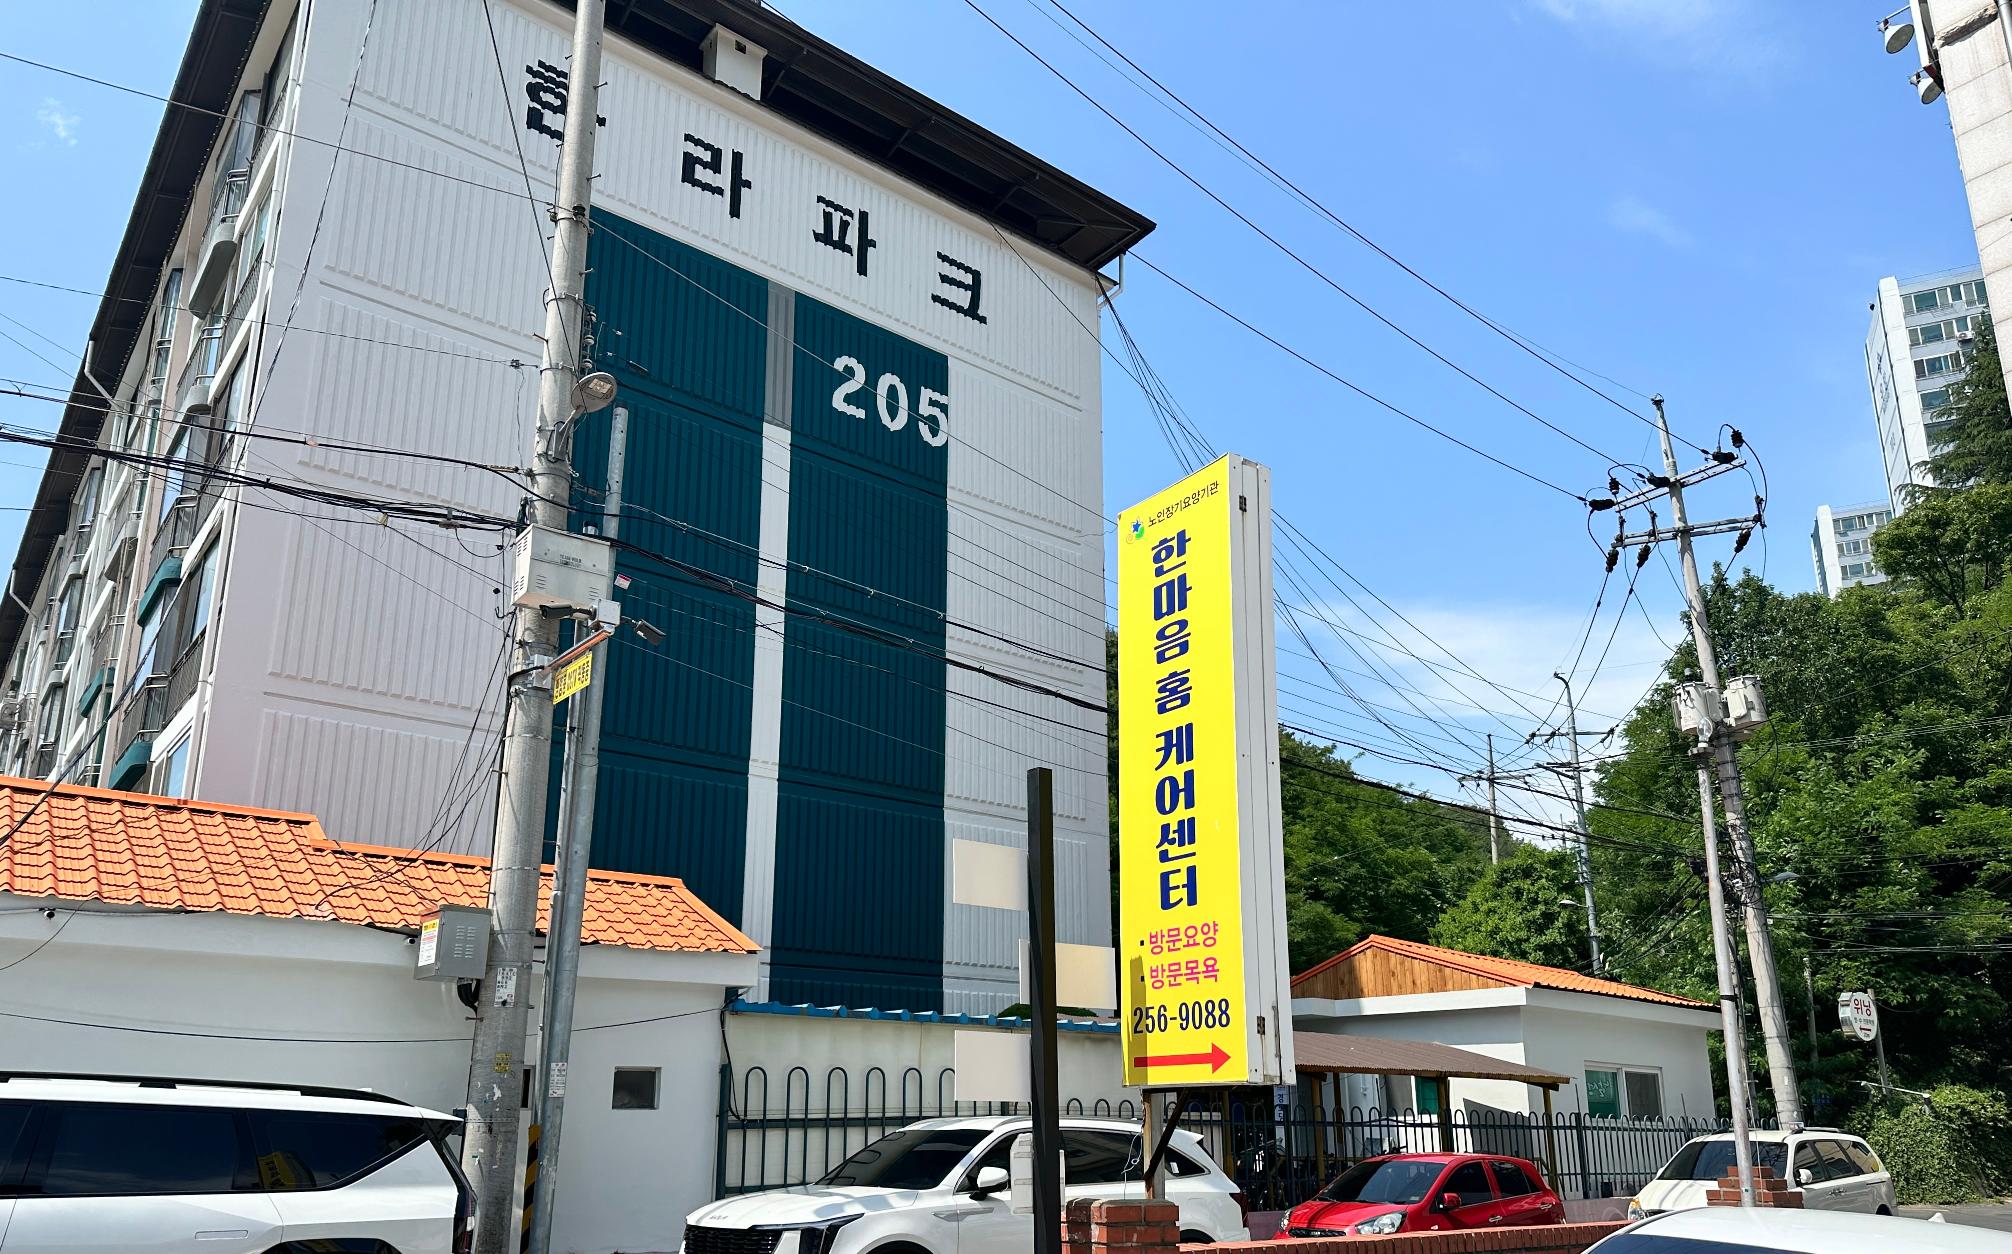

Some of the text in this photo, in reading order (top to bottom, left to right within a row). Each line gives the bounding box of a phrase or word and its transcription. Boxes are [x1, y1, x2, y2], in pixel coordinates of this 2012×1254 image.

[832, 355, 949, 447] 205
[1147, 480, 1220, 528] 노인장기요양기관
[1149, 920, 1219, 956] 방문요양
[1149, 956, 1220, 990] 방문목욕
[1133, 998, 1231, 1034] 256-9088
[1853, 998, 1872, 1017] 위닝
